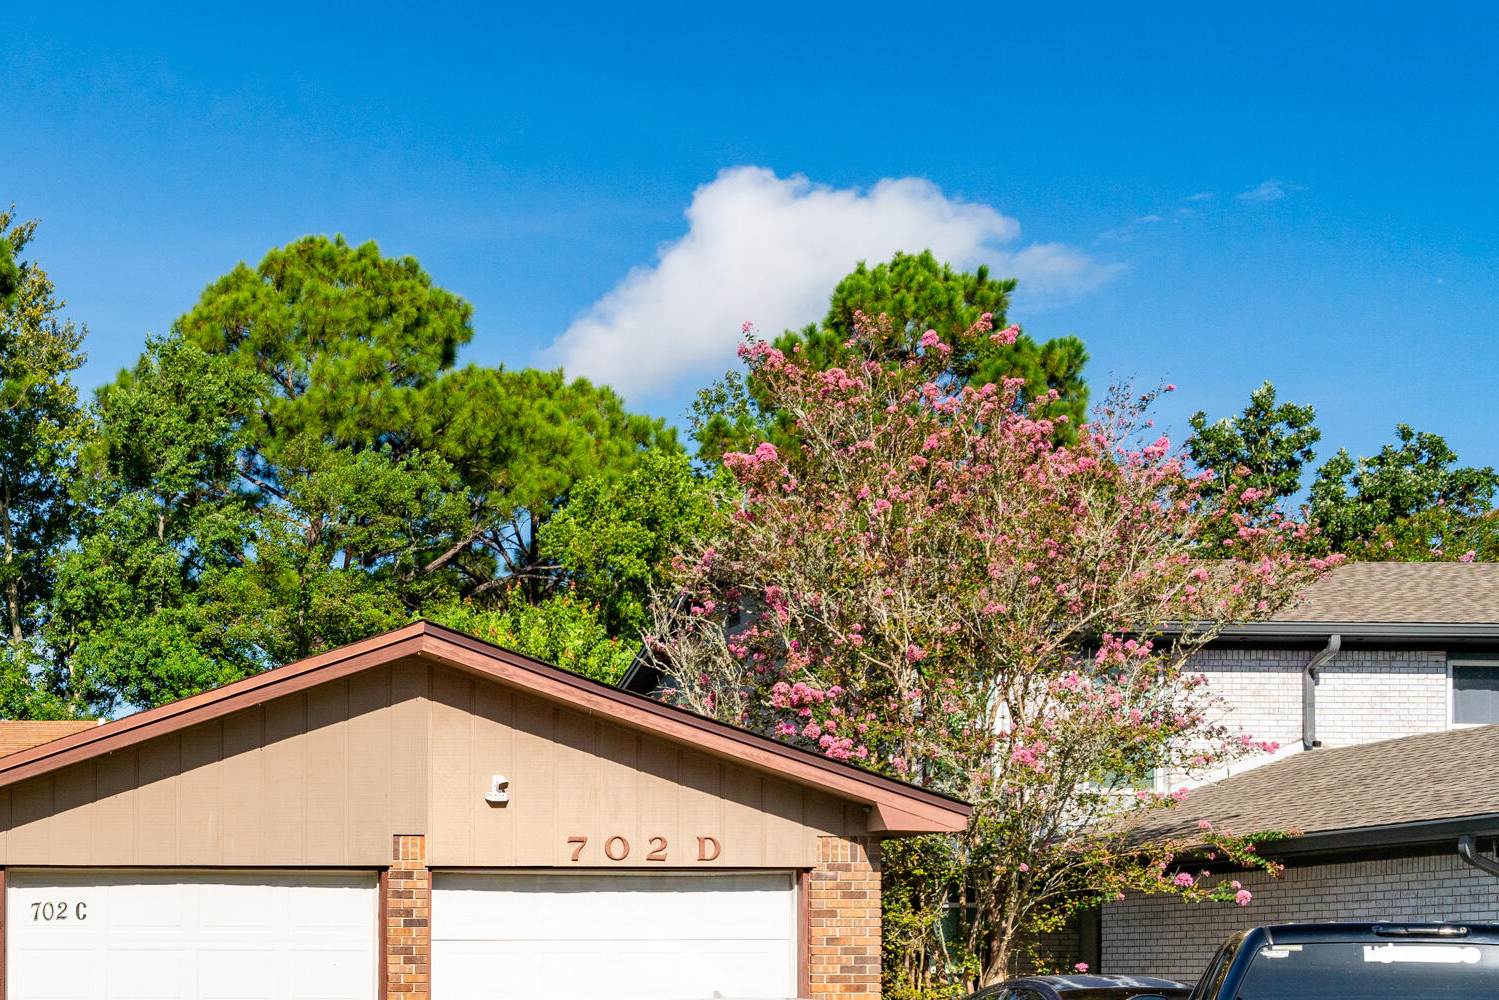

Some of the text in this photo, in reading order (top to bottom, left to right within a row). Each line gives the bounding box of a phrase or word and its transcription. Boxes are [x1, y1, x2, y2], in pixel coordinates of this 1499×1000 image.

[567, 835, 721, 861] 702 D
[31, 901, 87, 921] 702 C
